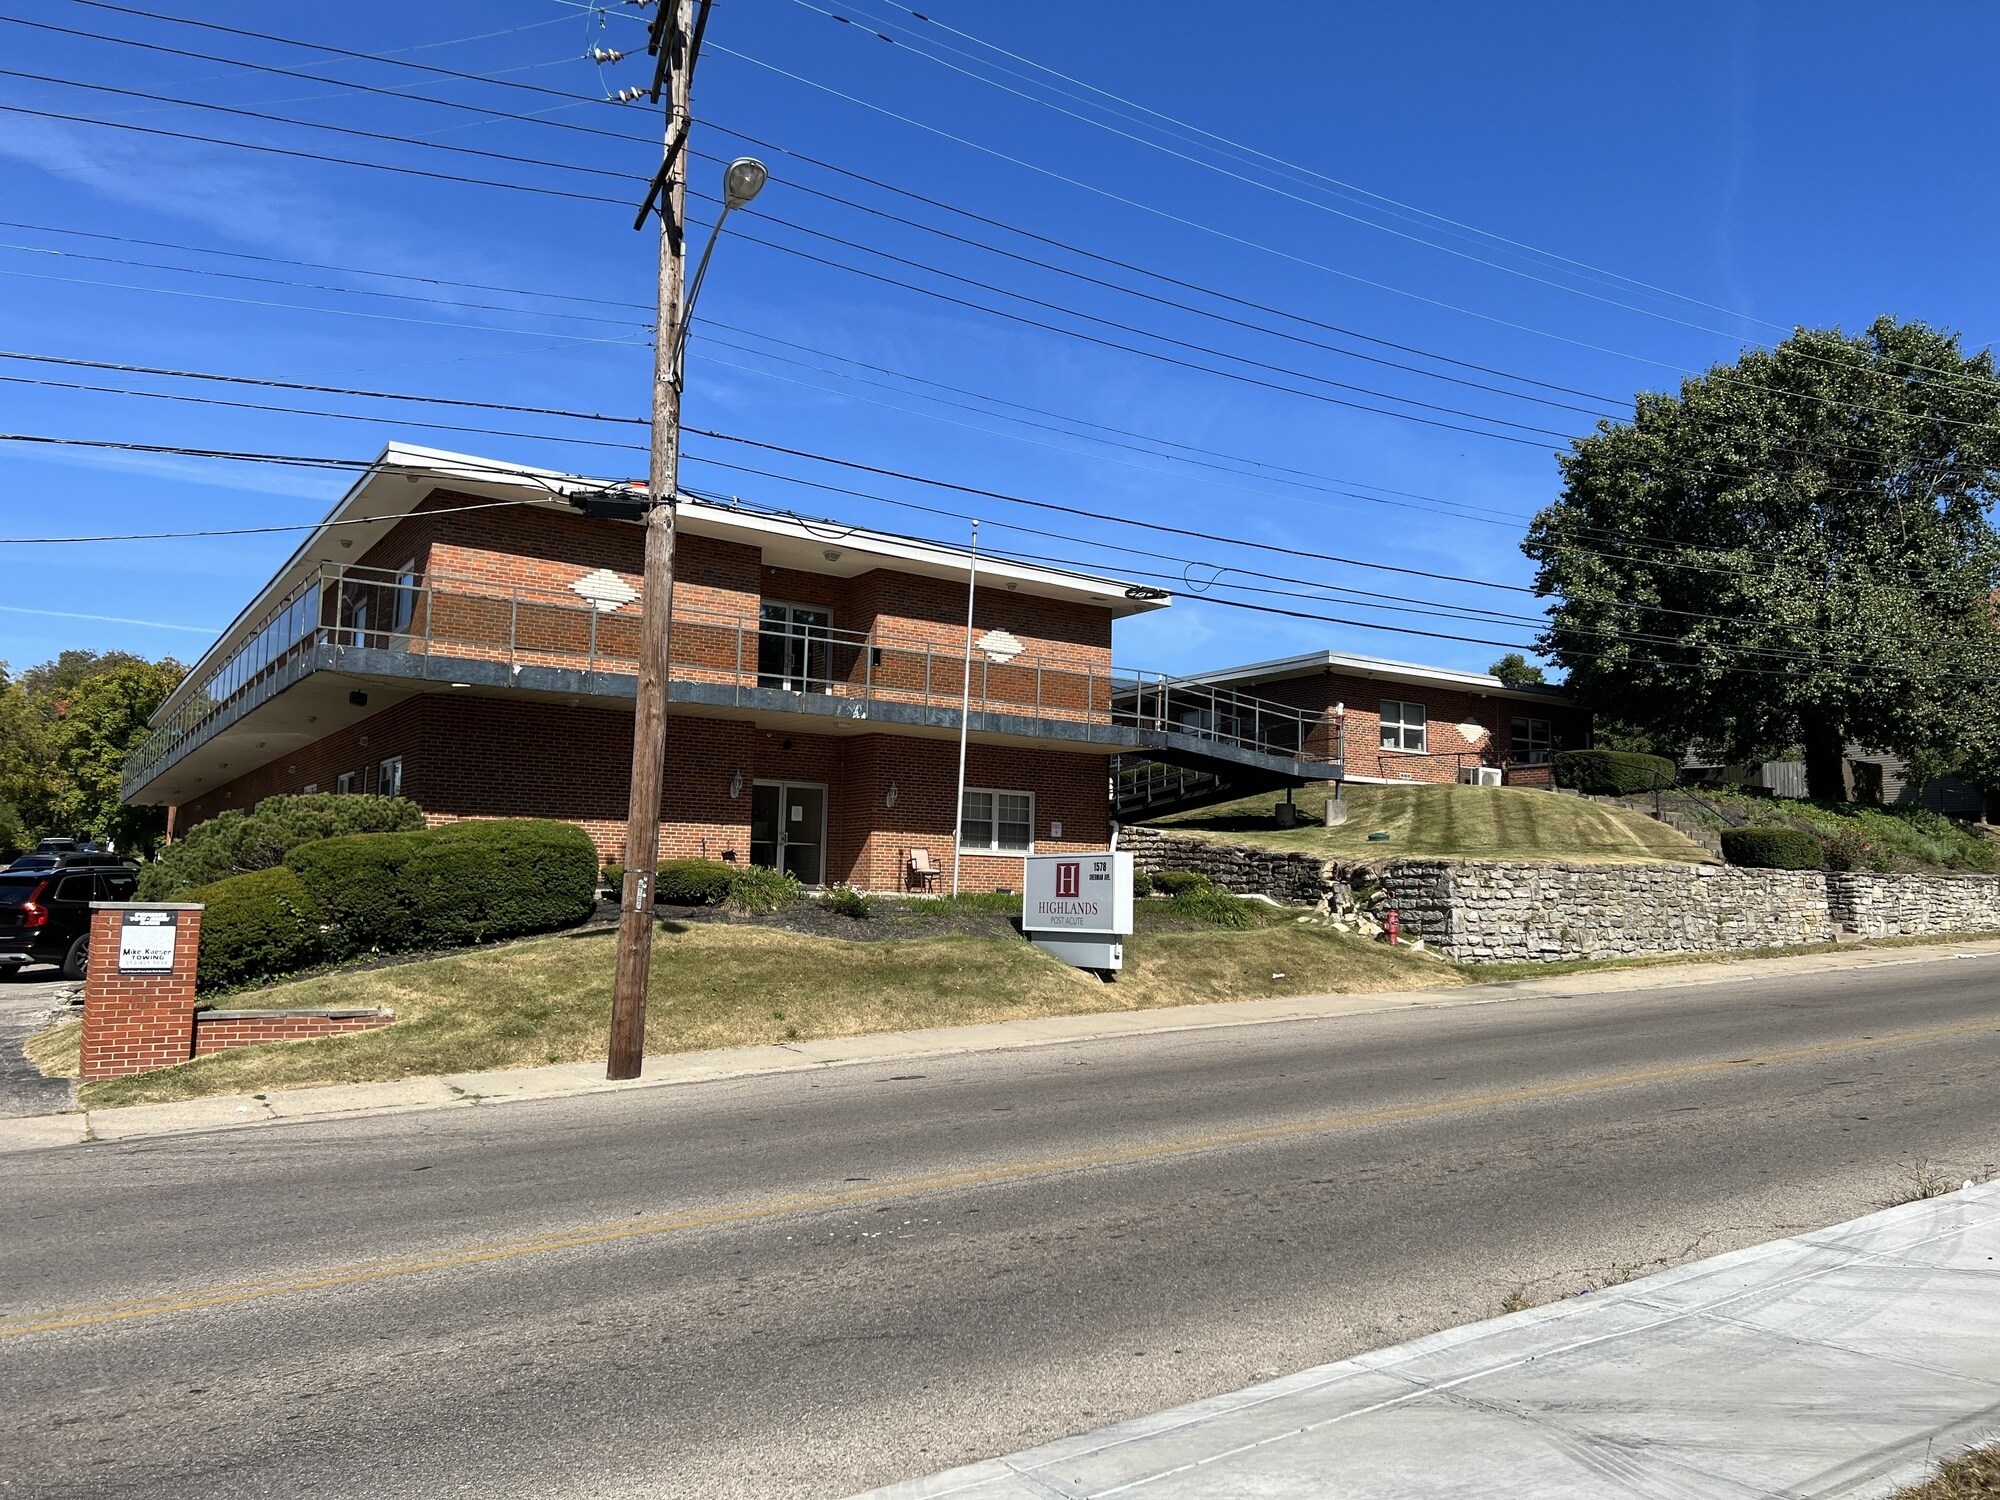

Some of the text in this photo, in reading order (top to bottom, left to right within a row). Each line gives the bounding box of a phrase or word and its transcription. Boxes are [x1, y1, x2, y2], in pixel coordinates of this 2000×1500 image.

[1093, 861, 1107, 872] 1578
[1059, 865, 1077, 894] H
[1038, 901, 1098, 915] HIGHLANDS
[1050, 916, 1084, 925] POST ACUTE
